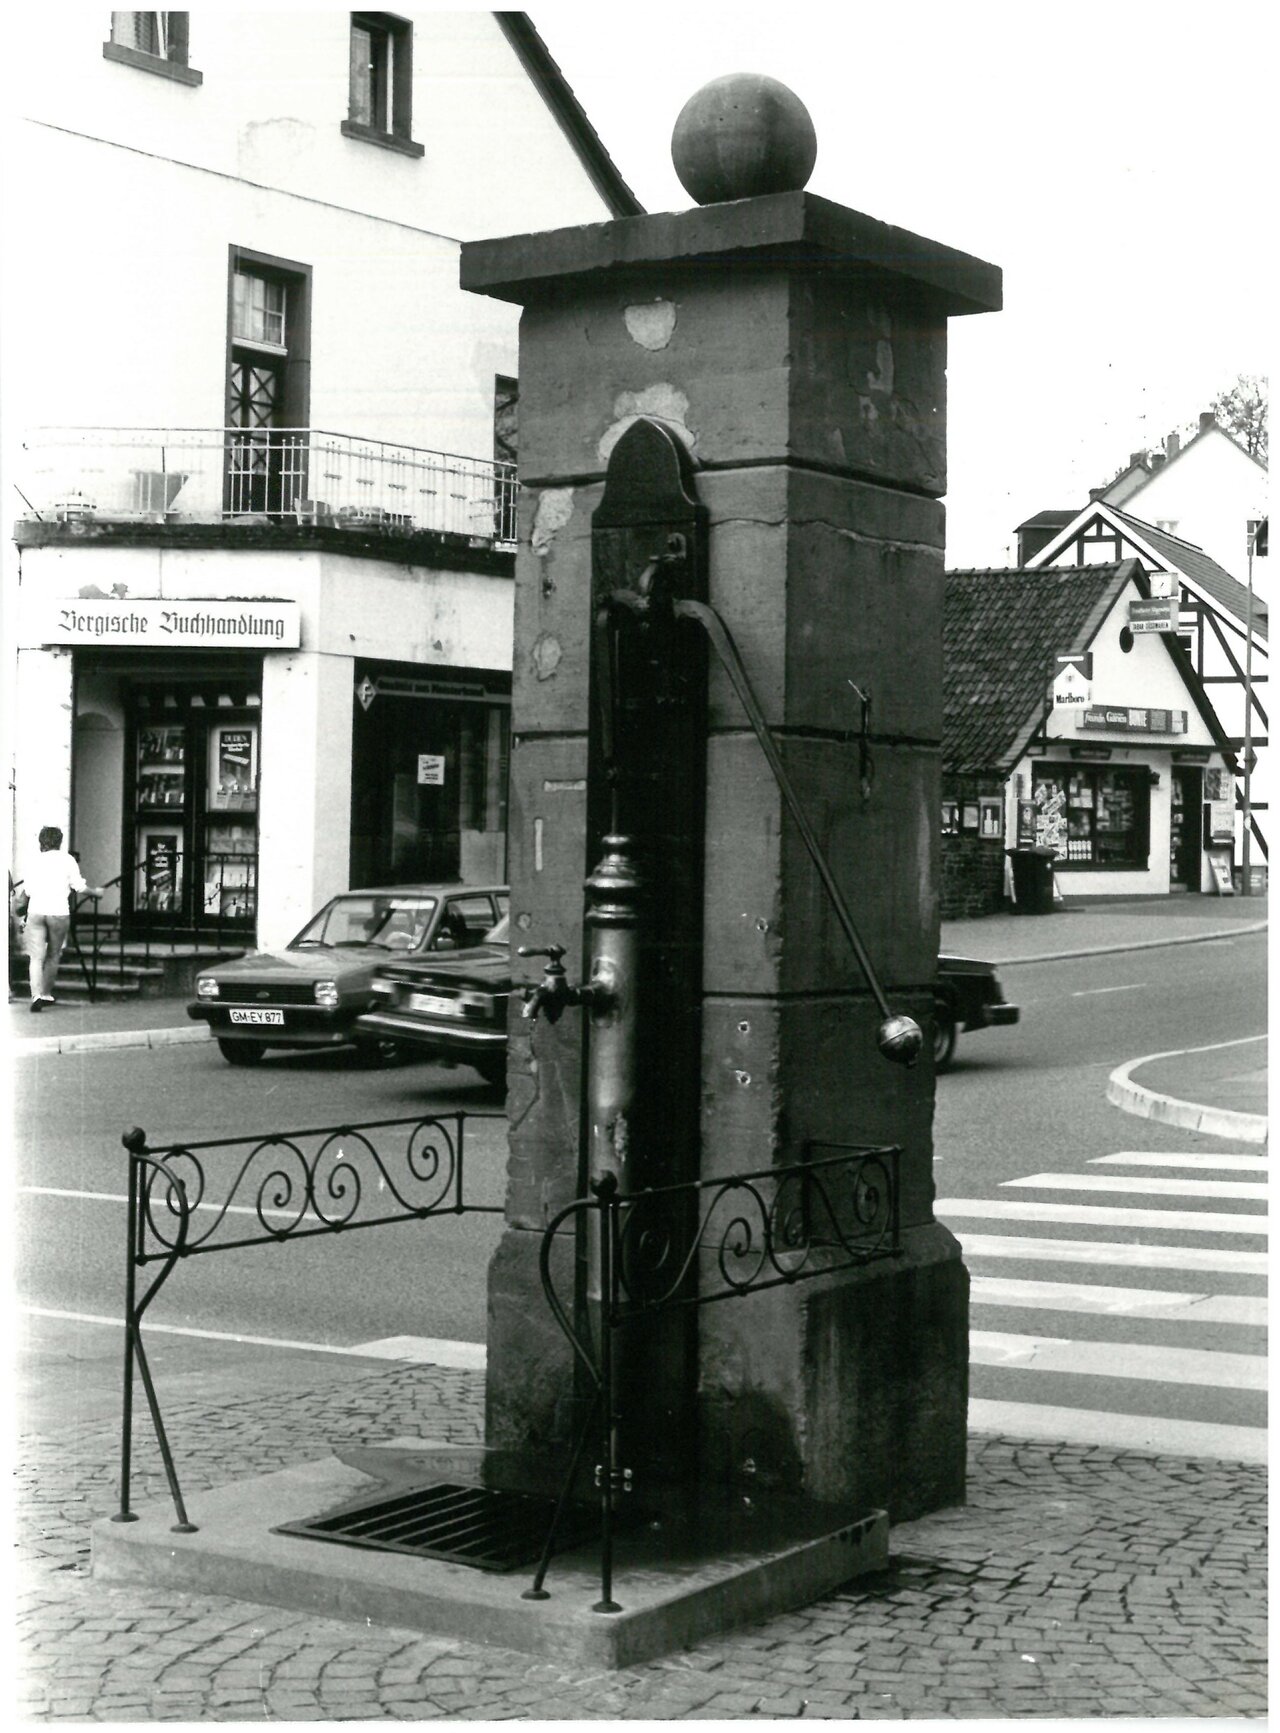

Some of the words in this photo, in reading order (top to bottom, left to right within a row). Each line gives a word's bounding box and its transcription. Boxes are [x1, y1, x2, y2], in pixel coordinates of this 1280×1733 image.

[58, 610, 148, 637] Bergische
[160, 611, 286, 640] Buchhandlung
[1056, 692, 1085, 703] Marlboro
[265, 1012, 281, 1023] 877
